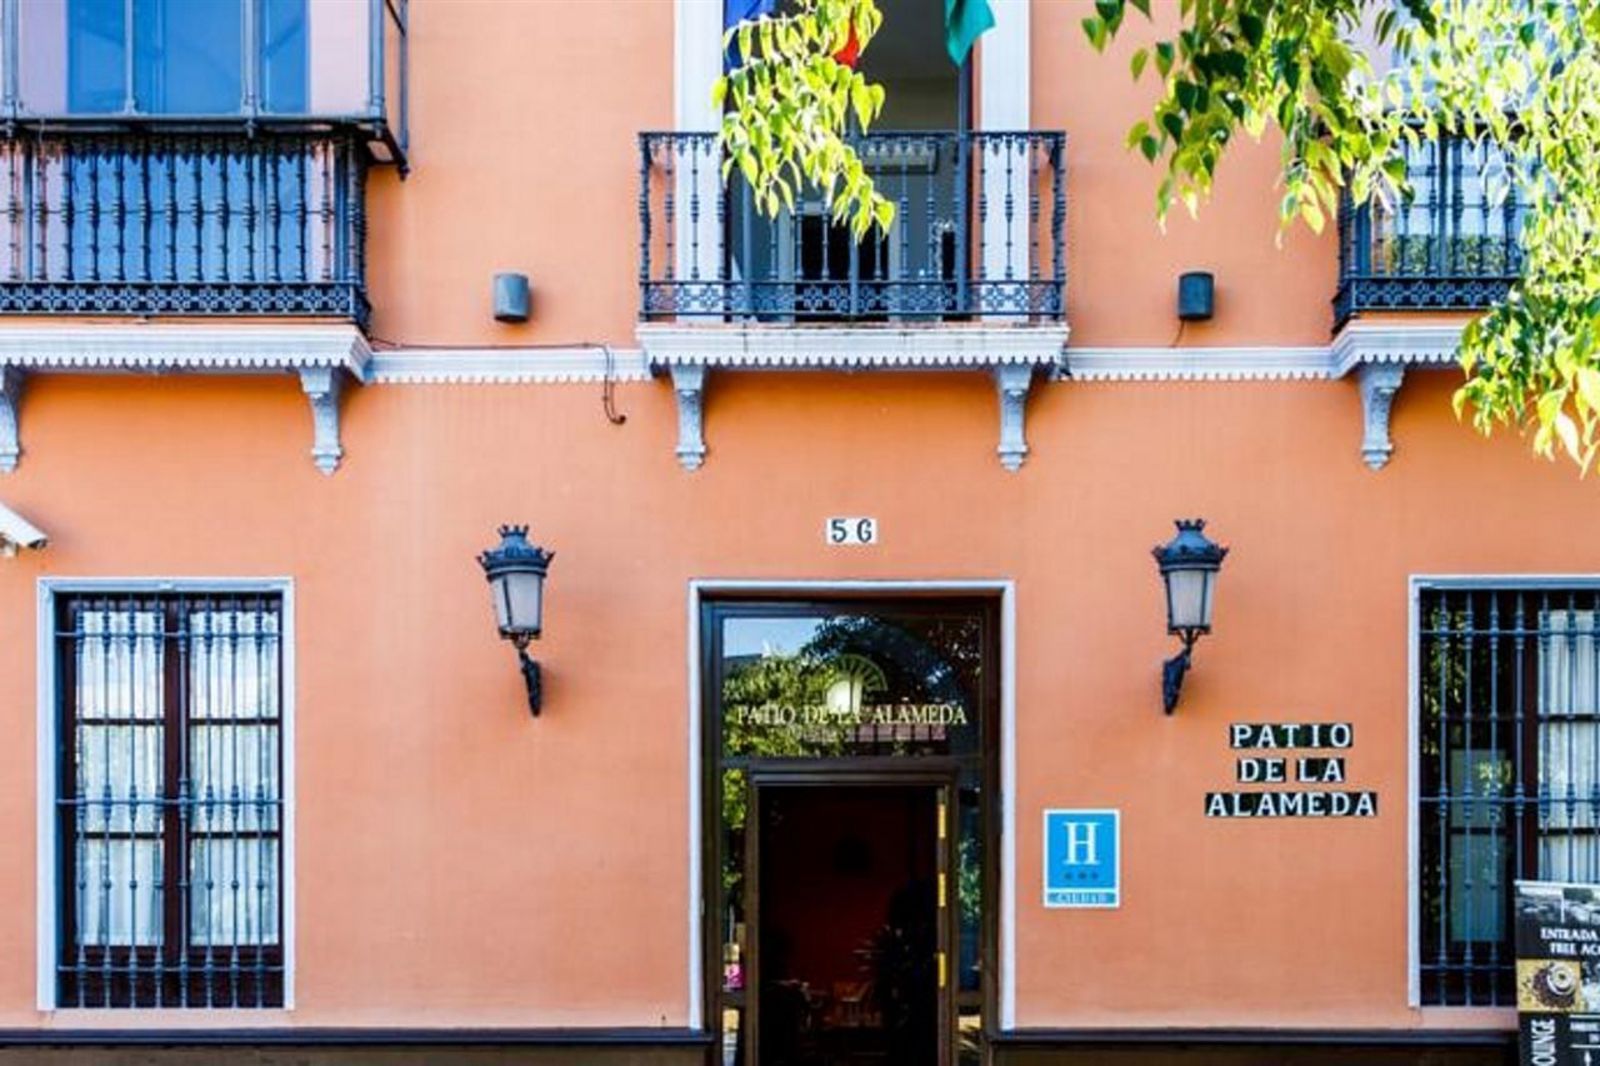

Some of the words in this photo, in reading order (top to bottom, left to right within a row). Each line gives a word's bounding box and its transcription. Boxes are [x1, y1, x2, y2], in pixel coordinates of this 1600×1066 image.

[737, 704, 796, 725] PATIO
[803, 704, 830, 725] DE
[837, 706, 862, 725] LA
[870, 703, 967, 725] ALAMEDA
[1232, 724, 1351, 748] PATIO
[1240, 759, 1284, 782] DE
[1299, 759, 1343, 782] LA
[1207, 793, 1375, 817] ALAMEDA
[1062, 821, 1101, 866] H
[1540, 927, 1598, 941] ENTRADA
[1580, 943, 1600, 956] AC
